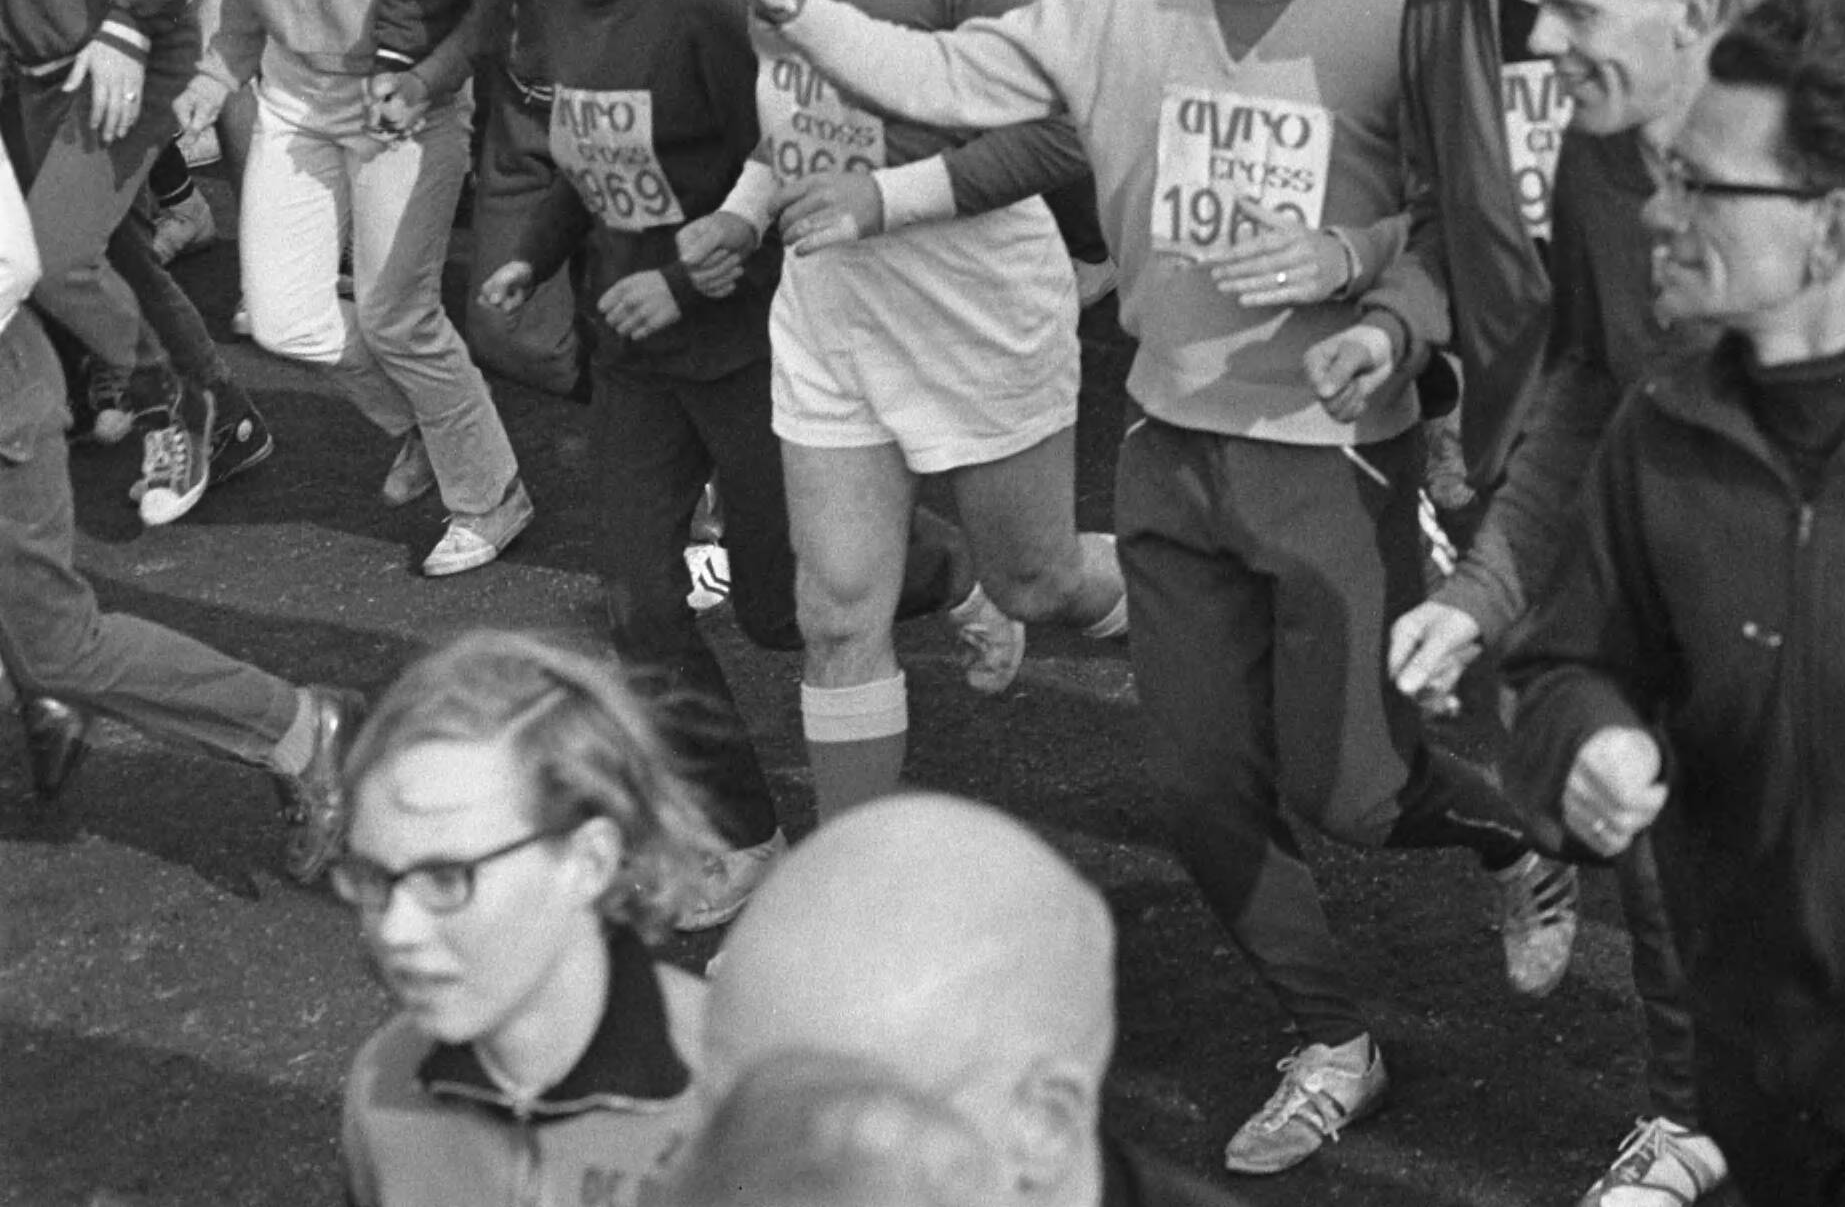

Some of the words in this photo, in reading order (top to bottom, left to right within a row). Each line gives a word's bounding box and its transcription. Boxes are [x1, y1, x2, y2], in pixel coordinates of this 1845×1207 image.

[1178, 99, 1311, 150] avro
[570, 167, 671, 219] 969
[1209, 155, 1314, 192] cross
